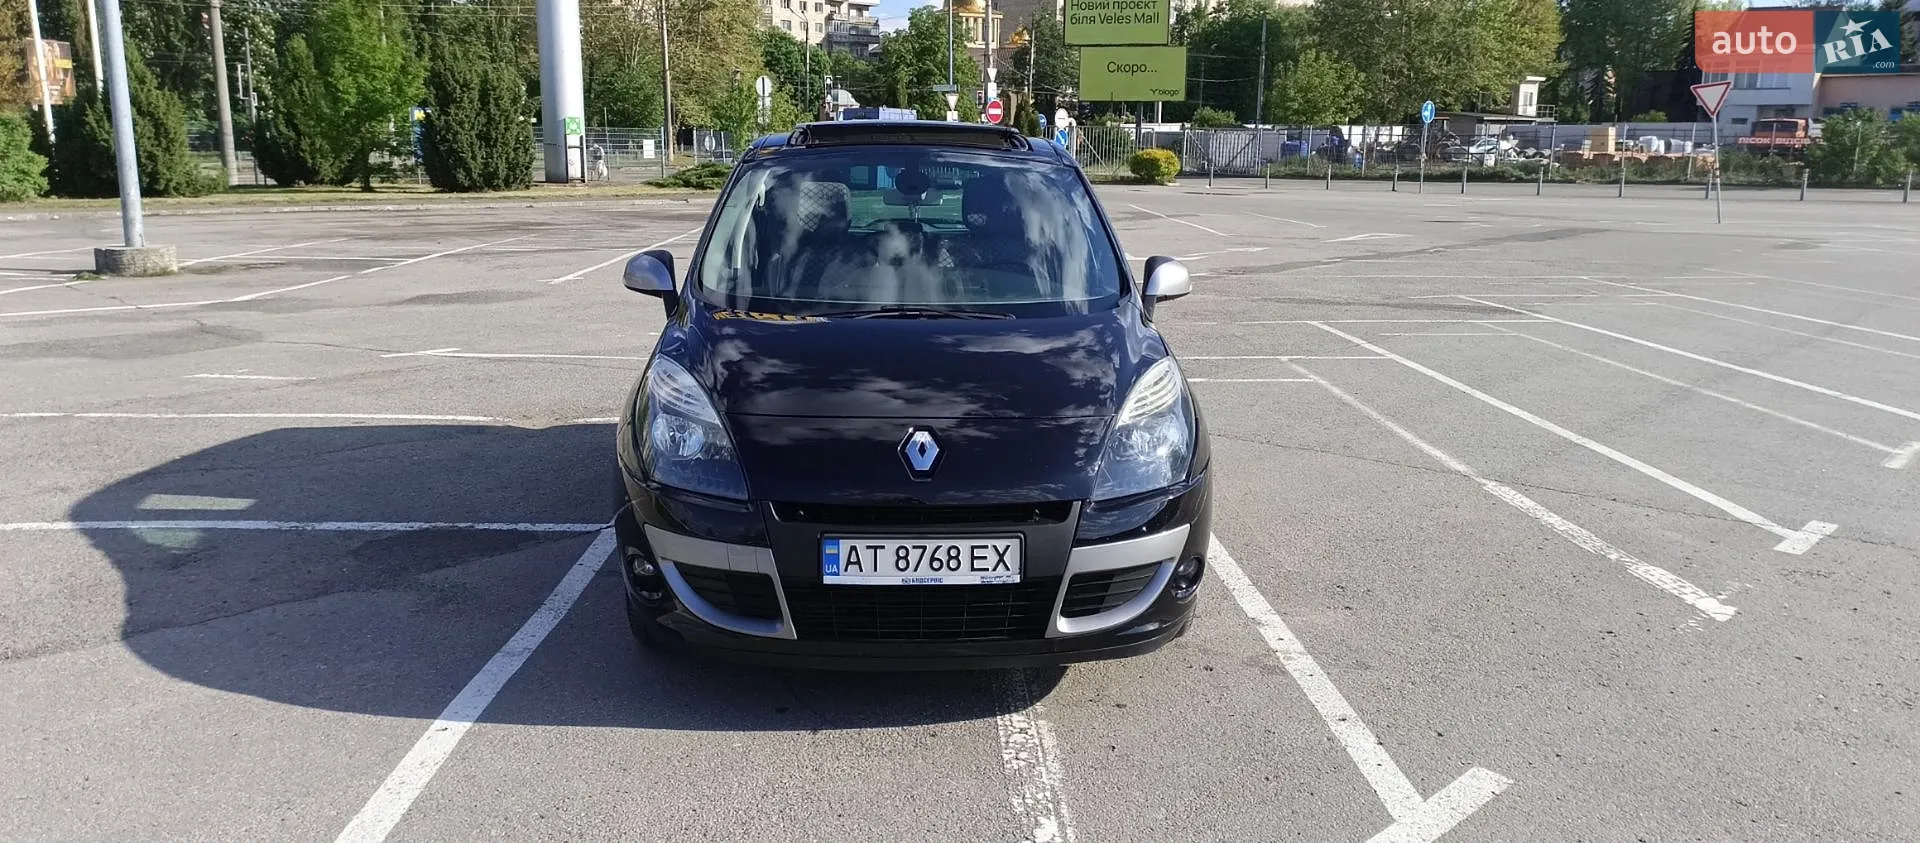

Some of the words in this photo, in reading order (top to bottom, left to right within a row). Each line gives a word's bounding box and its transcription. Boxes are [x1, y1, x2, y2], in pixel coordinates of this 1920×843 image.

[1070, 0, 1110, 11] Новий
[1112, 0, 1157, 13] проєкт
[1070, 13, 1096, 25] біля
[1098, 12, 1131, 25] Veles
[1134, 12, 1160, 24] Mall
[1106, 61, 1157, 76] Скоро...
[843, 544, 885, 573] AT
[894, 544, 962, 573] 8768
[970, 544, 1011, 573] EX
